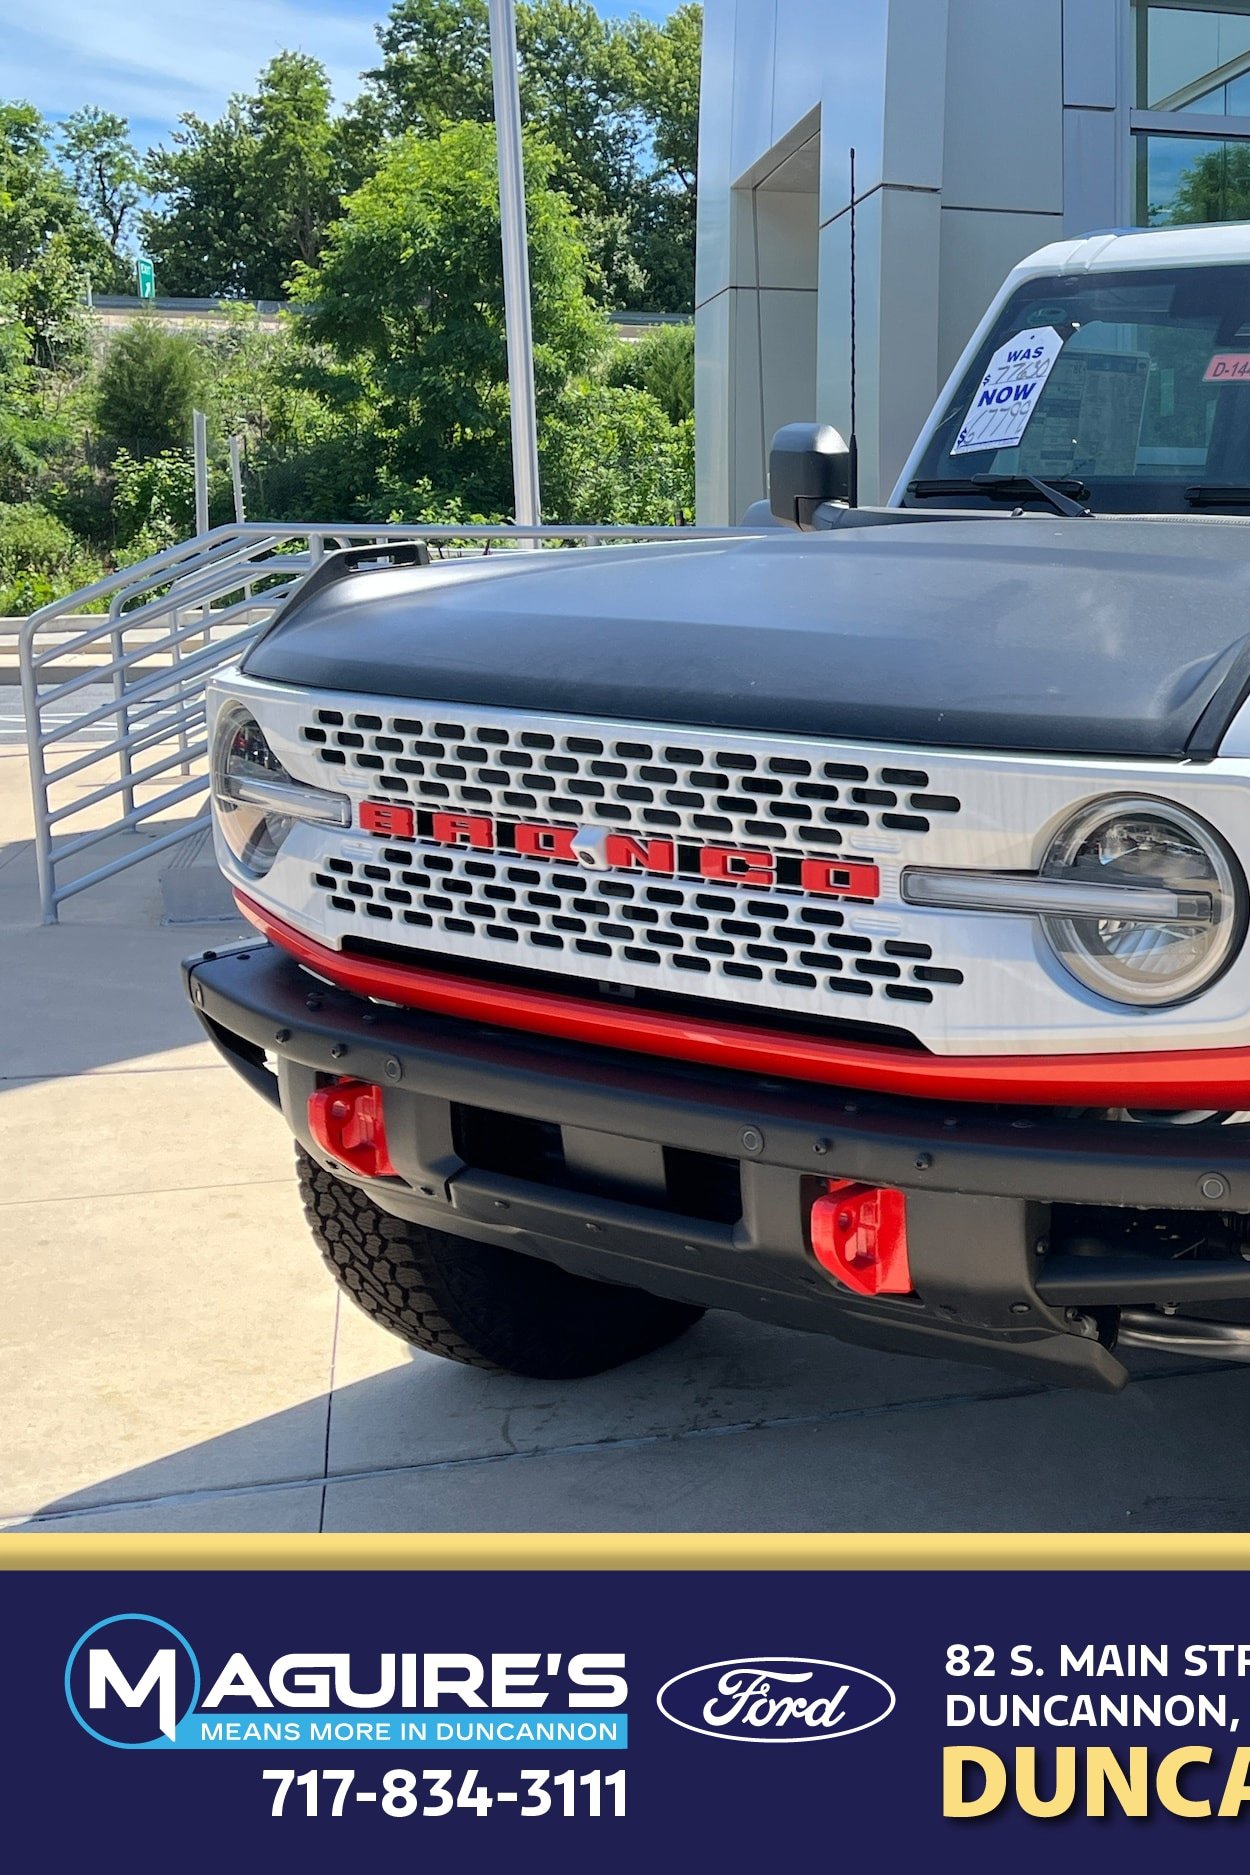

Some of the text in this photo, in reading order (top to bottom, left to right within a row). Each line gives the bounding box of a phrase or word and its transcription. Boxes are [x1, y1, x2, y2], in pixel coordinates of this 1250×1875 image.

[1006, 346, 1045, 363] WAS
[977, 383, 1037, 408] NOW
[358, 800, 880, 899] BRONCO
